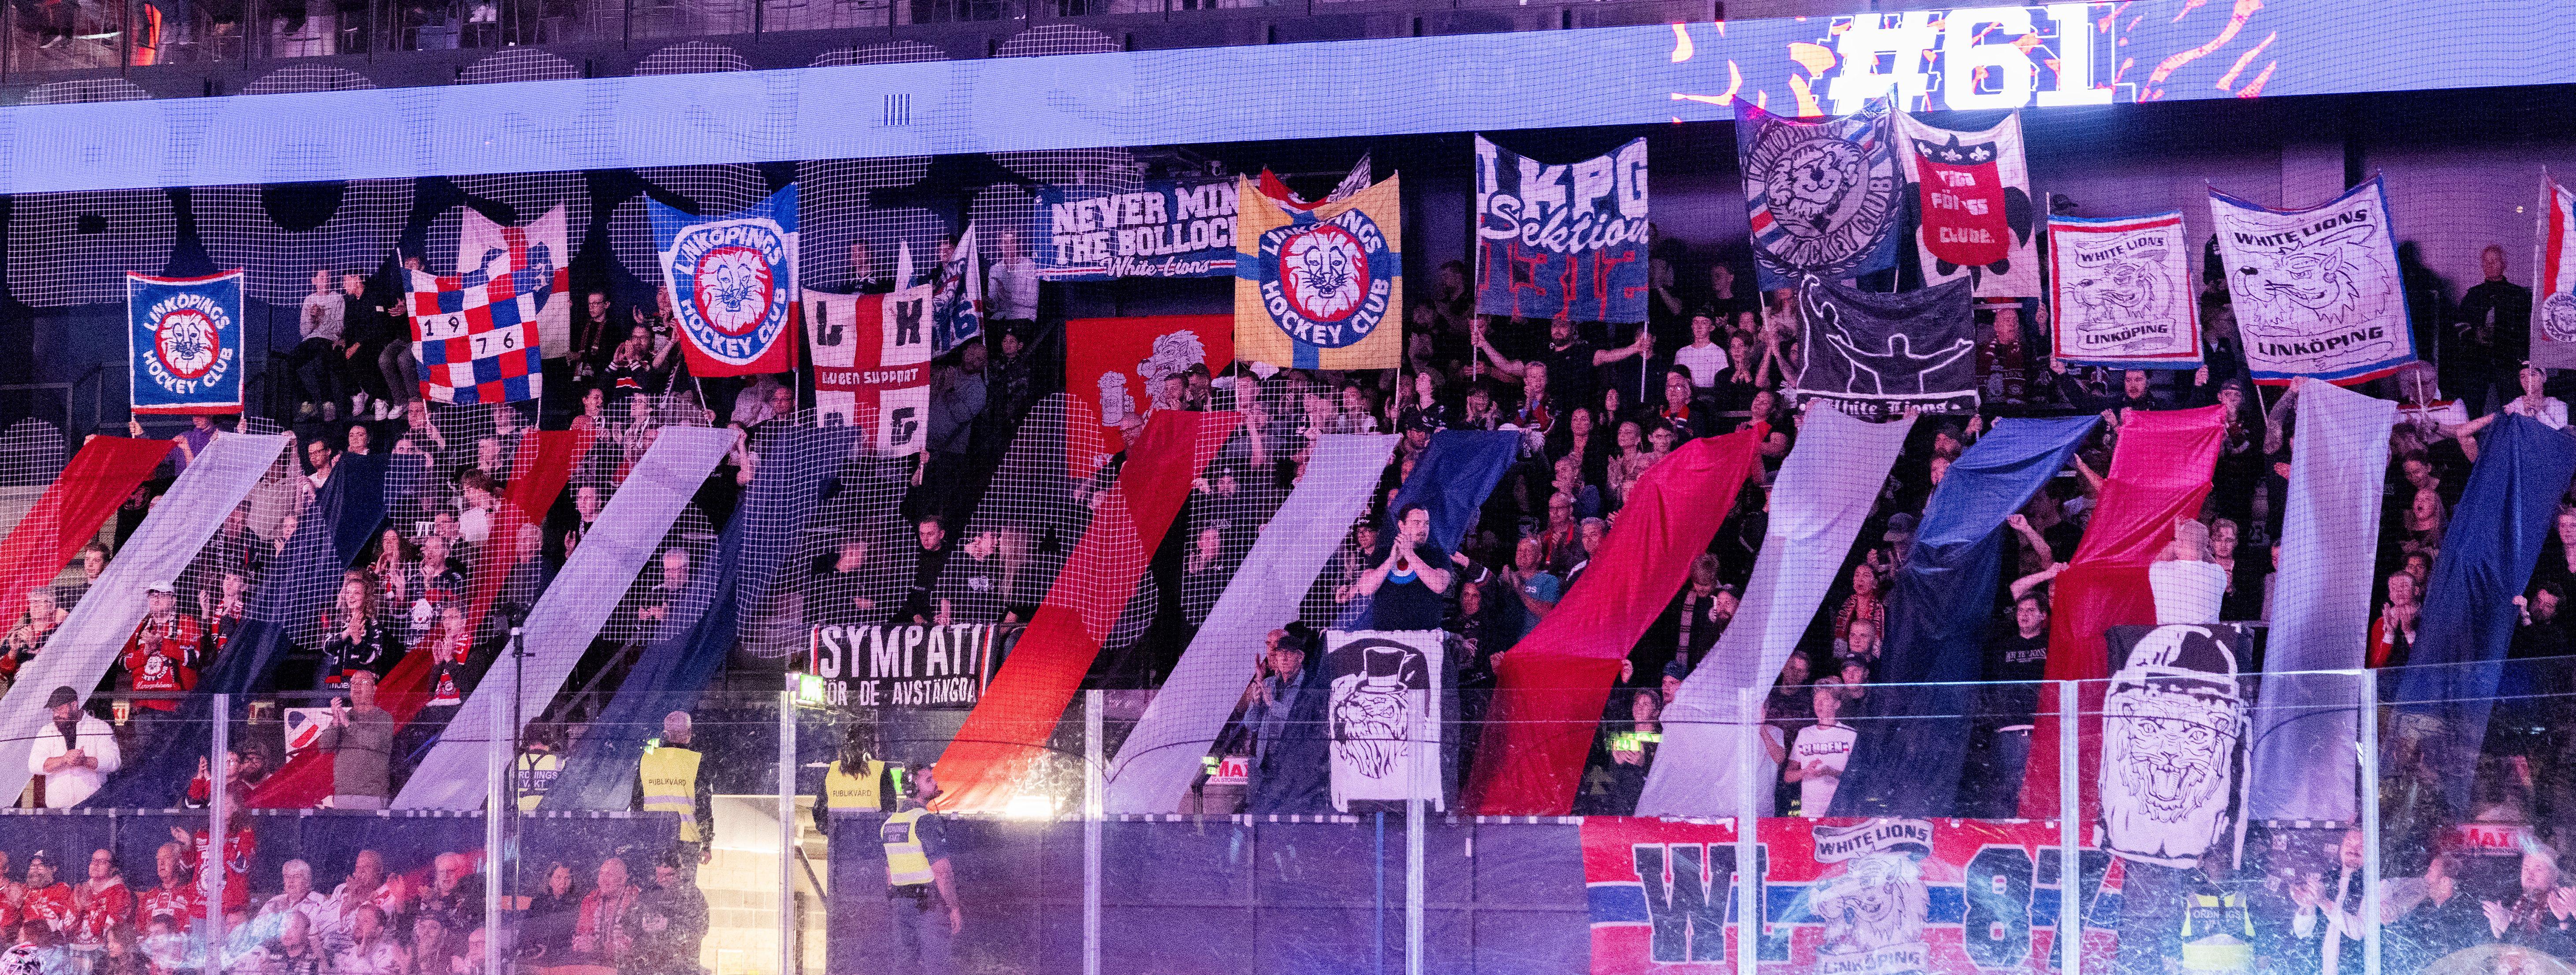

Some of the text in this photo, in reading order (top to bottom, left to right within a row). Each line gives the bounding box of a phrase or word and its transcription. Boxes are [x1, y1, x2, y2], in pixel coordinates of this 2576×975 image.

[1827, 4, 2113, 114] #61
[1052, 192, 1167, 235] NEVER
[1480, 194, 1648, 254] Sektion
[1852, 177, 1892, 236] CLUB
[1261, 210, 1382, 256] LINKÖINGS
[2234, 209, 2368, 245] WHITE LIONS
[676, 225, 783, 275] LINKÖPINGS
[1052, 231, 1109, 265] THE
[1100, 256, 1211, 278] White Lions
[2081, 236, 2164, 262] WHITE LIONS
[143, 292, 232, 332] LINKÖPINGS
[679, 287, 787, 357] HOCKEY CLUB
[1263, 279, 1389, 344] HOCKEY CLUB
[2086, 324, 2168, 344] LINKÖPING
[2257, 326, 2384, 356] LINKÖPING
[143, 347, 233, 394] HOCKEY CLUB
[863, 368, 919, 386] SUPPORT
[820, 623, 981, 678] SYMPATI
[860, 680, 880, 706] DE
[892, 677, 977, 706] AVSTÄNGDA
[523, 779, 546, 788] VKT
[1818, 824, 1929, 855] WHITE LIONS
